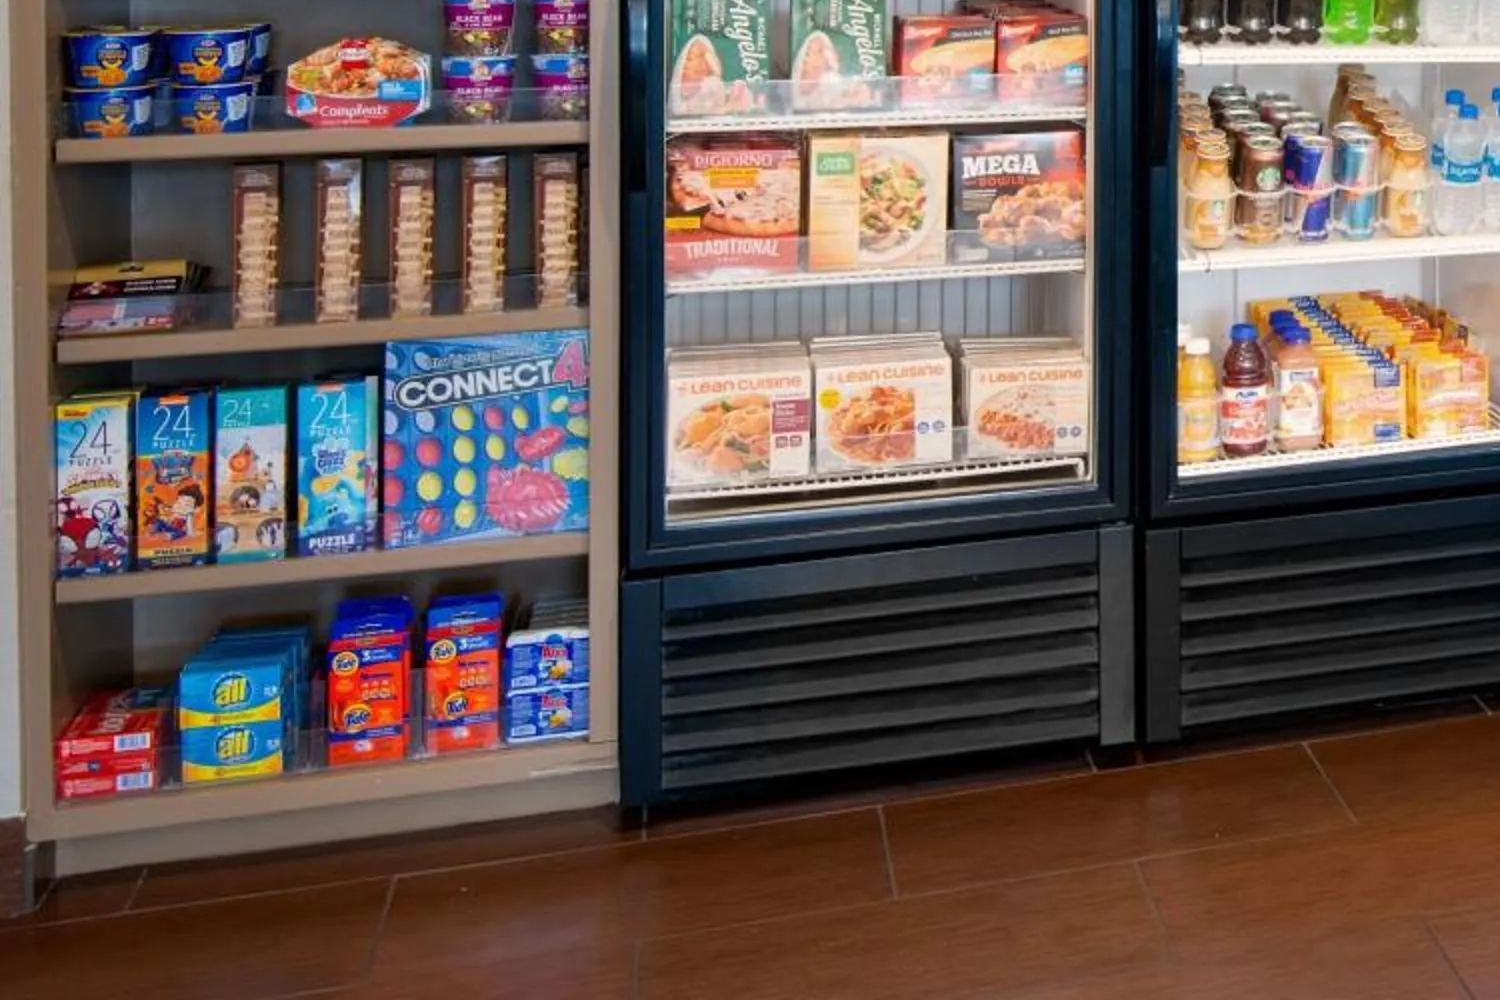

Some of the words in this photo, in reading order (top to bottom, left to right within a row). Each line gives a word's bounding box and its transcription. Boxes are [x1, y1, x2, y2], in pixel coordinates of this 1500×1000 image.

[961, 153, 1041, 179] MEGA
[684, 237, 780, 259] TRADITIONAL
[399, 358, 553, 407] CONNECT
[552, 340, 587, 387] 4
[152, 404, 195, 441] 24
[222, 399, 252, 423] 24
[310, 391, 352, 428] 24
[69, 420, 113, 459] 24
[214, 676, 248, 708] all
[217, 730, 250, 762] all
